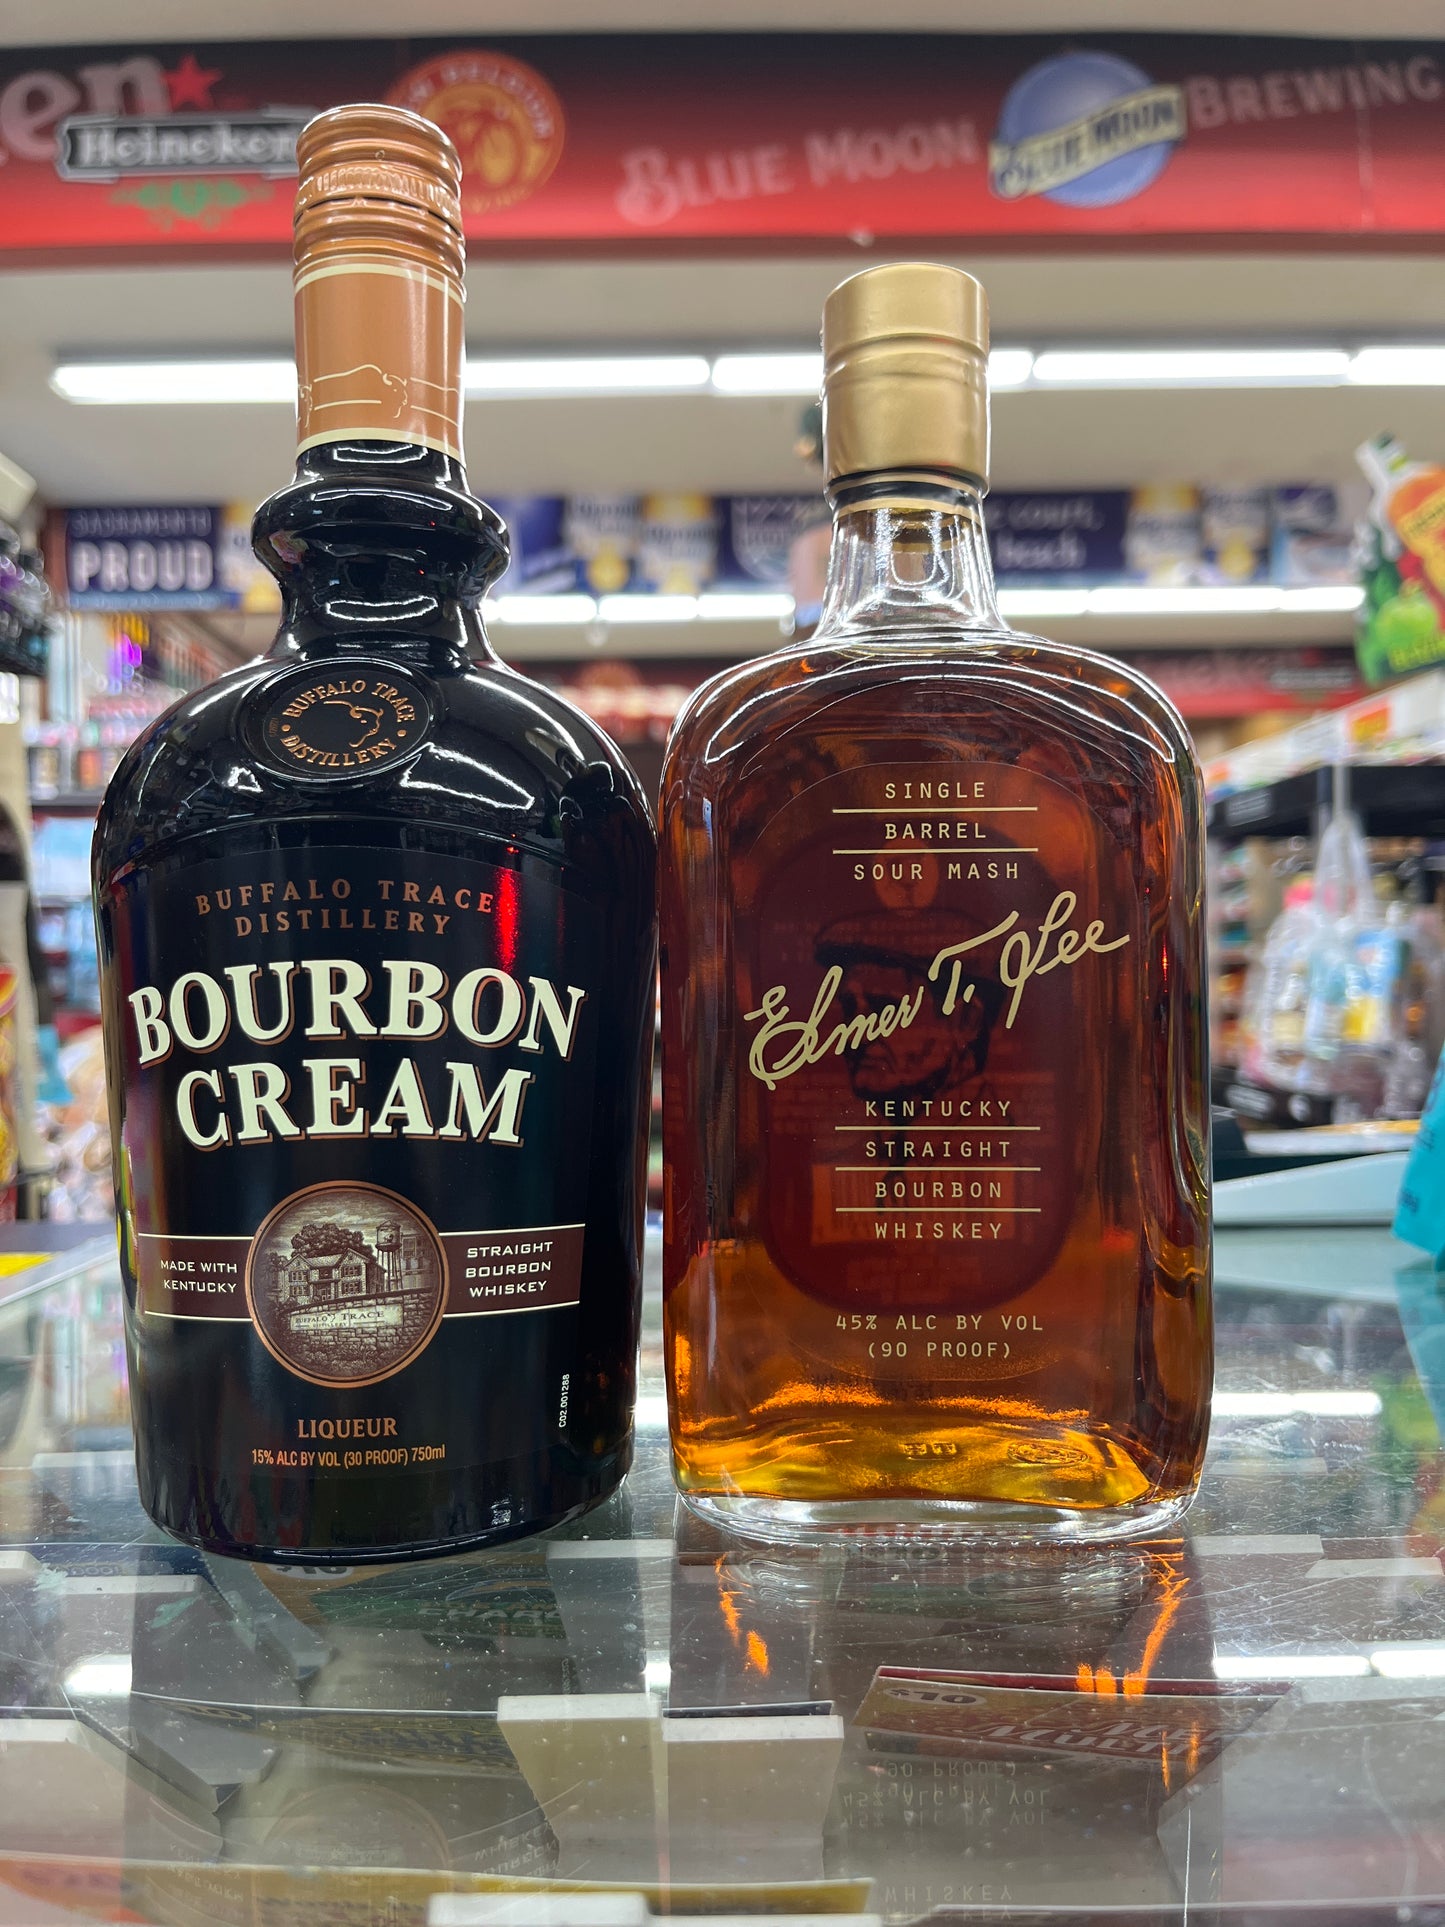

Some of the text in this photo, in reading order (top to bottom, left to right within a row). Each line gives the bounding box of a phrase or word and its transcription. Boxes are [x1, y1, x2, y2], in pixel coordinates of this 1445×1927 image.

[1092, 97, 1175, 144] MOON
[615, 146, 794, 227] BLUE
[805, 119, 978, 188] MOON
[1187, 56, 1444, 129] BREWING
[72, 540, 213, 592] PROUD
[282, 680, 416, 723] BUFFALO TRACE
[280, 734, 397, 767] DISTILLERY
[885, 782, 987, 799] SINGLE
[885, 822, 988, 840] BARREL
[853, 862, 1020, 881] SOUR MASH
[196, 878, 496, 916] BUFFALO TRACE
[235, 909, 452, 938] DISTILLERY
[743, 965, 925, 1091] Elmer
[999, 889, 1131, 1029] Lee
[127, 958, 589, 1070] BOURBON
[176, 1056, 536, 1151] CREAM
[865, 1100, 1011, 1117] KENTUCKY
[865, 1141, 1011, 1157] STRAIGHT
[875, 1182, 1002, 1198] BOURBON
[875, 1222, 1003, 1239] WHISKEY
[467, 1241, 553, 1259] STRAIGHT
[160, 1259, 238, 1274] MADE WITH
[465, 1261, 552, 1279] BOURBON
[163, 1279, 237, 1294] KENTUCKY
[469, 1280, 547, 1298] WHISKEY
[341, 1311, 385, 1321] TRACE
[836, 1314, 1043, 1331] 45% ALC BY VOL
[868, 1342, 1011, 1358] (90 PROOF)
[297, 1417, 399, 1440] LIQUEUR
[252, 1443, 446, 1469] 15% ALC BY VOL (30 PROOF) 750ml
[889, 1688, 978, 1704] $10
